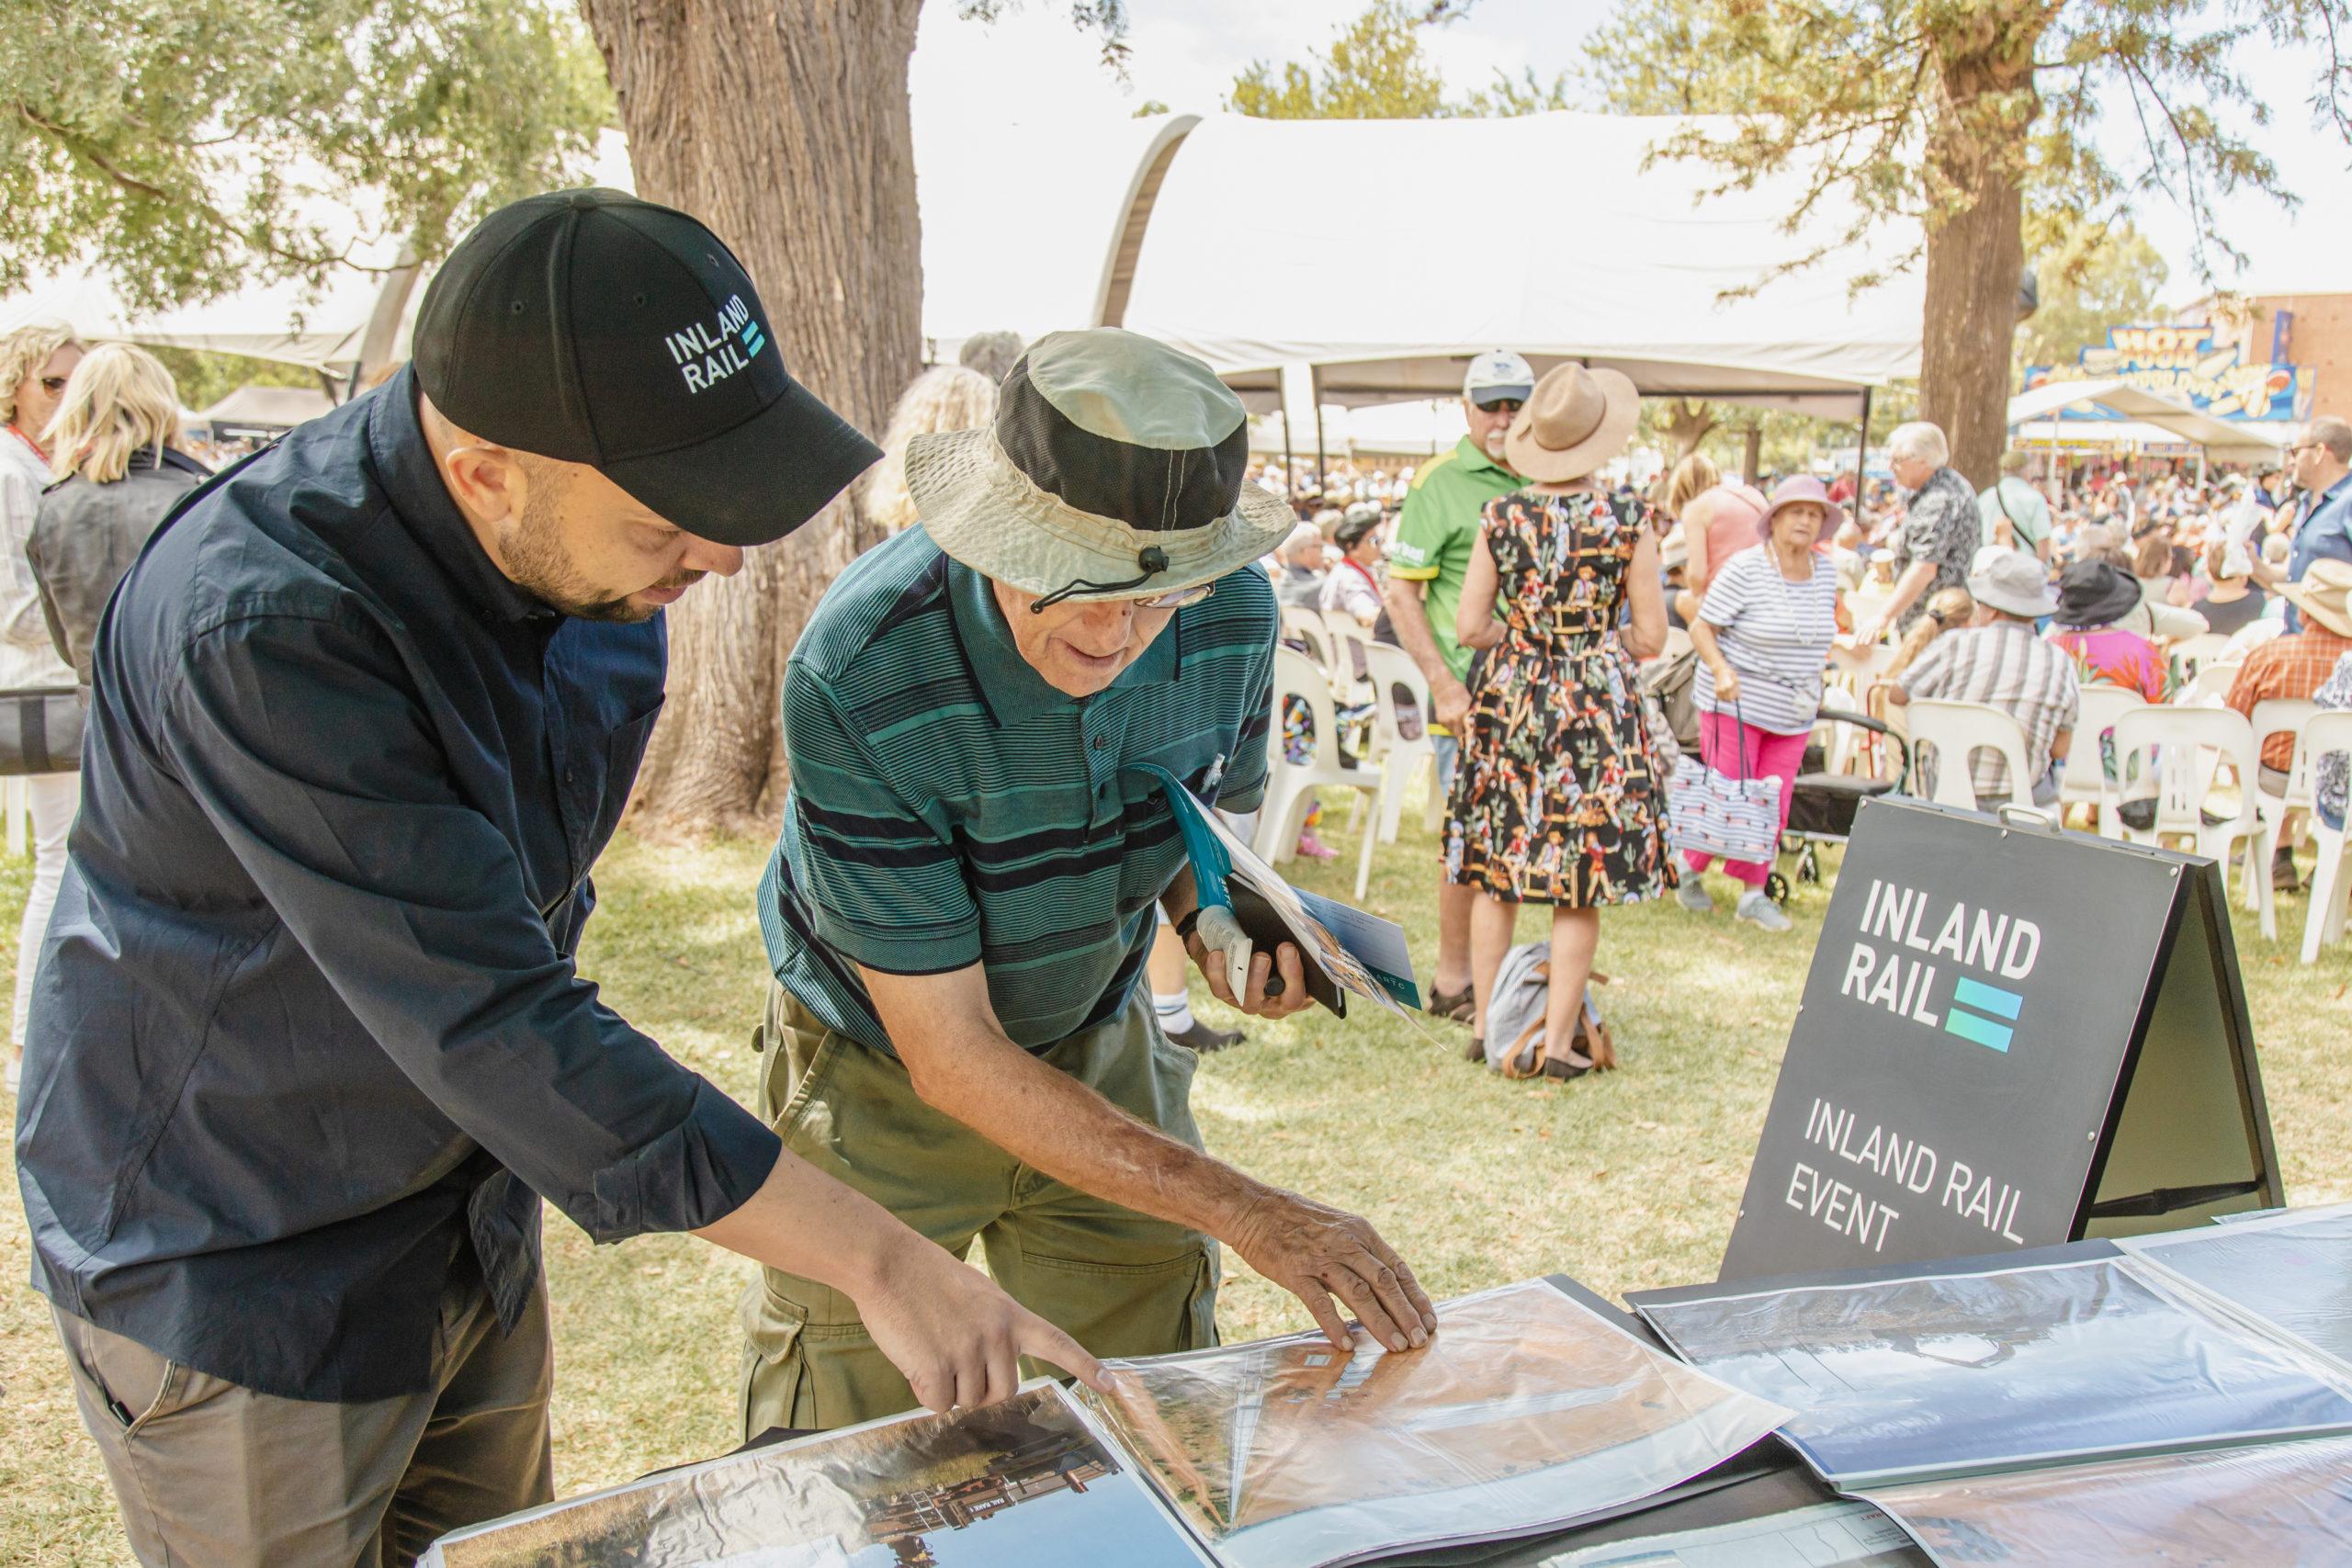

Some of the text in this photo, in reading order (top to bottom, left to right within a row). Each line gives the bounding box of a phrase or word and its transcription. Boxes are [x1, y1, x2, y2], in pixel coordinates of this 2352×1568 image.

[665, 294, 749, 364] INLAND
[2111, 328, 2212, 352] HOT
[682, 344, 749, 393] RAIL
[1858, 879, 2041, 980] INLAND
[1840, 942, 1938, 1027] RAIL
[1786, 1162, 1899, 1252] EVENT
[1804, 1097, 2023, 1245] INLAND RAIL
[1860, 1511, 1885, 1521] RAFT
